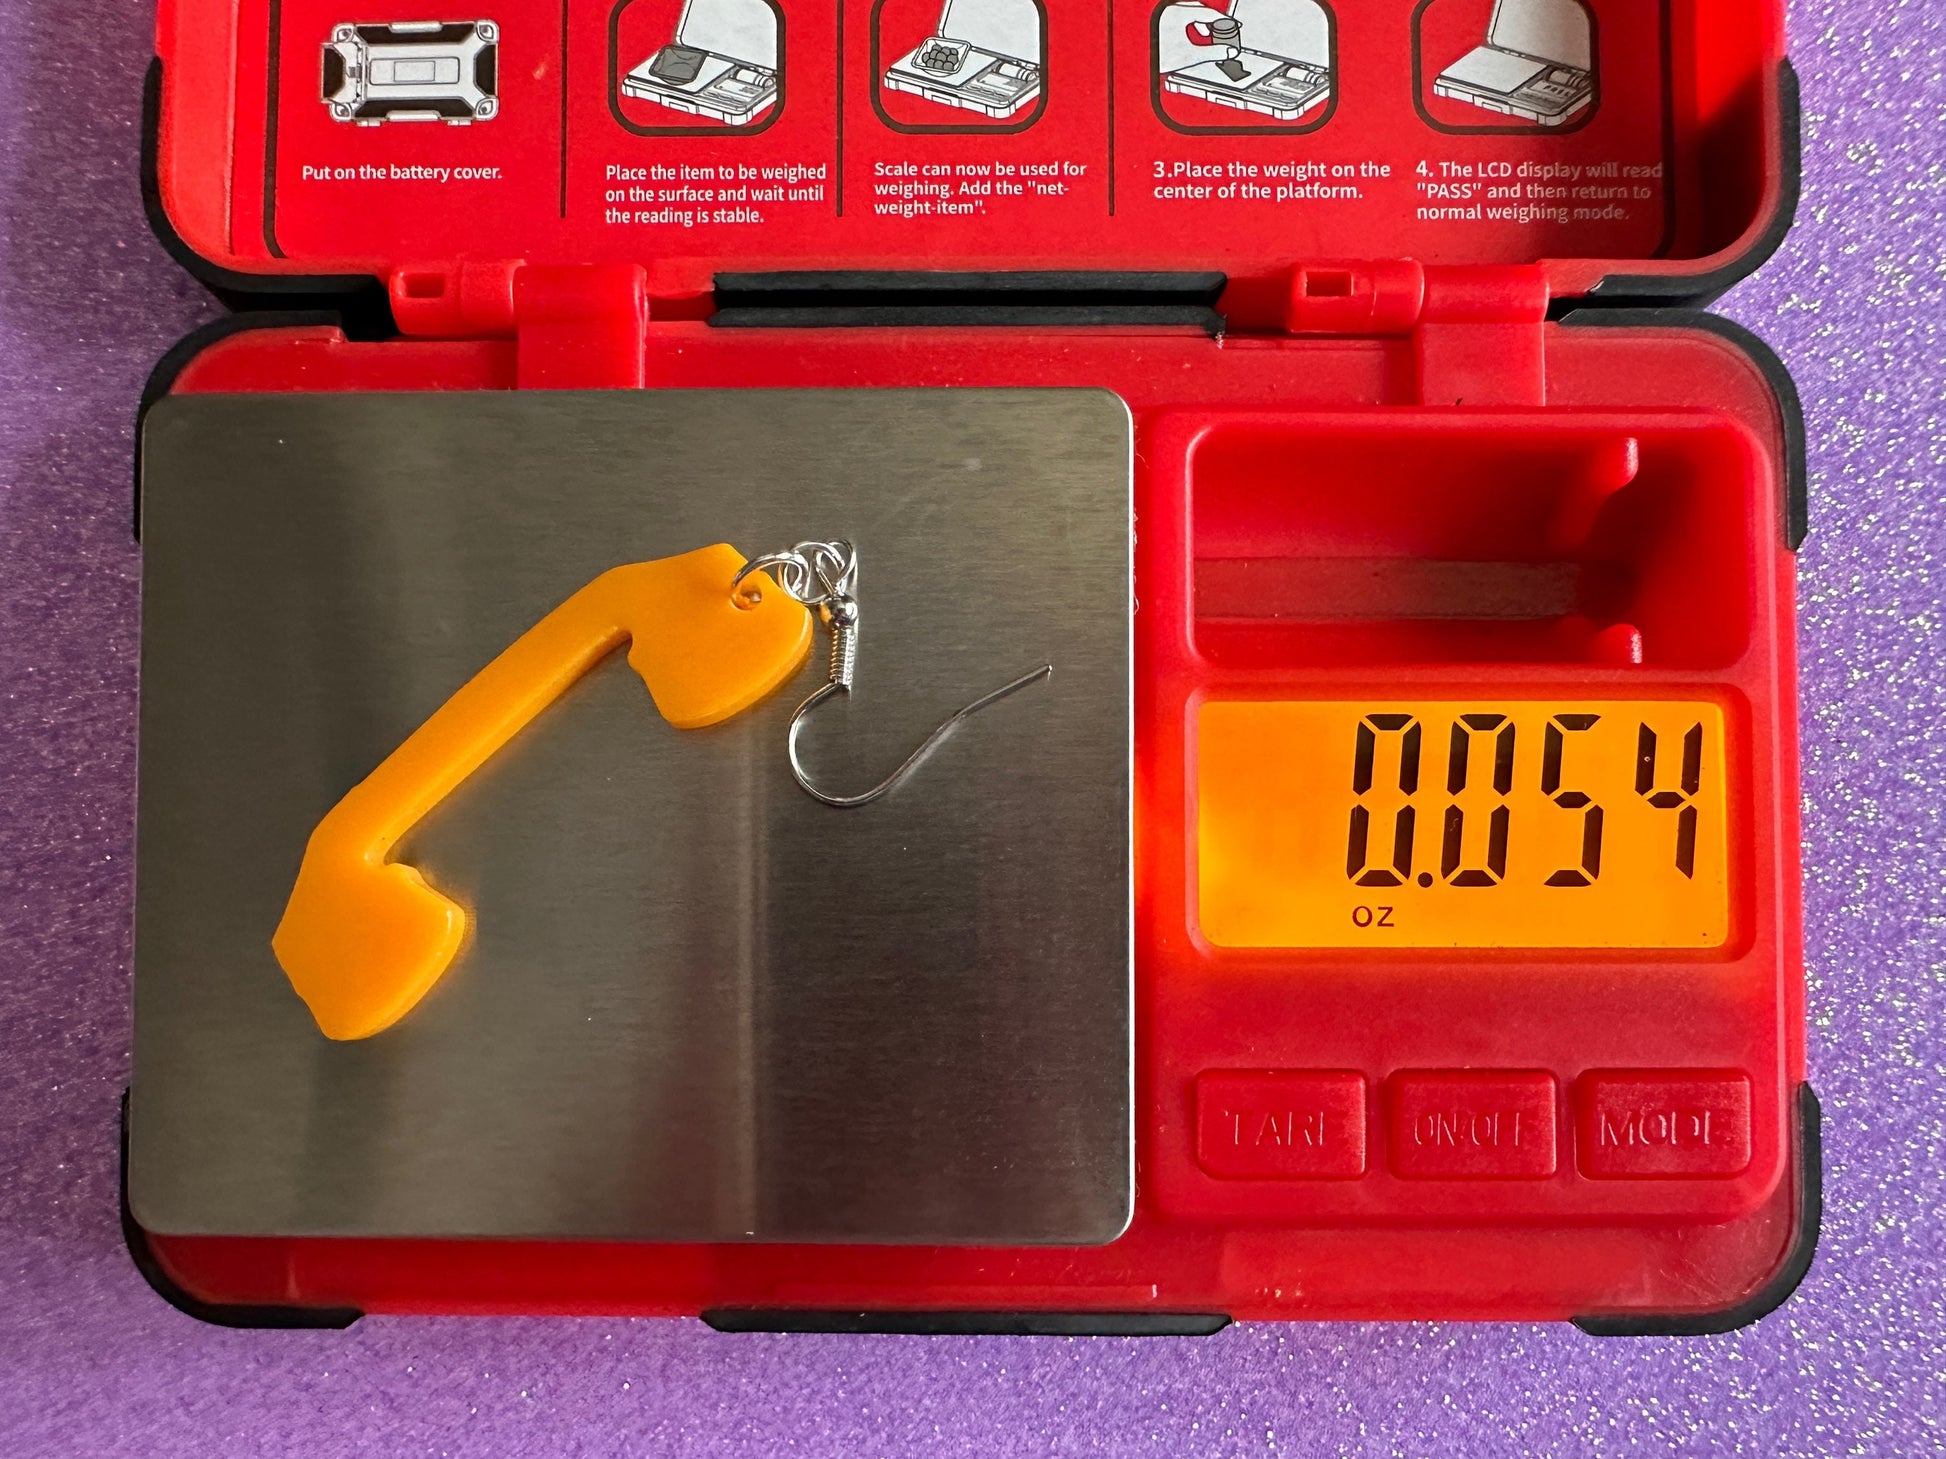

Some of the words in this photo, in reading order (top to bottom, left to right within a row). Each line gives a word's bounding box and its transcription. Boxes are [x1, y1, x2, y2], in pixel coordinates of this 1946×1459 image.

[301, 164, 332, 181] Put
[333, 167, 356, 181] on
[357, 163, 387, 180] the
[389, 163, 451, 184] battery
[453, 166, 503, 180] cover.
[605, 163, 648, 181] Place
[649, 163, 677, 181] the
[679, 163, 715, 181] item
[717, 164, 735, 181] to
[738, 162, 758, 180] be
[760, 162, 827, 184] weighed
[873, 160, 919, 177] Scale
[921, 164, 952, 177] can
[955, 164, 992, 177] now
[995, 160, 1016, 177] be
[1019, 160, 1059, 177] used
[1062, 160, 1088, 177] for
[1226, 160, 1259, 178] the
[1262, 160, 1327, 182] weight
[1330, 164, 1355, 178] on
[1359, 160, 1391, 178] the
[1415, 159, 1435, 178] 4.
[1437, 160, 1473, 178] The
[1477, 161, 1513, 178] LCD
[1516, 160, 1582, 182] display
[604, 189, 626, 203] on
[628, 185, 655, 203] the
[657, 184, 714, 202] surface
[717, 184, 747, 202] and
[750, 184, 785, 202] wait
[788, 184, 824, 202] until
[873, 179, 955, 200] weighing.
[958, 179, 992, 196] Add
[994, 179, 1024, 196] the
[1027, 179, 1070, 196] "net-
[1152, 183, 1214, 199] center
[1217, 181, 1238, 199] of
[1240, 181, 1272, 200] the
[1276, 181, 1364, 203] platform.
[1416, 181, 1482, 200] "PASS"
[1486, 181, 1521, 199] and
[1525, 182, 1568, 199] then
[1571, 185, 1628, 199] return
[1632, 186, 1652, 199] to
[604, 206, 631, 225] the
[634, 206, 694, 228] reading
[696, 206, 710, 224] is
[712, 205, 765, 224] stable.
[873, 199, 987, 219] weight-item".
[1416, 202, 1483, 221] normal
[1485, 202, 1570, 225] weighing
[1345, 712, 1703, 889] 0.054
[1600, 1108, 1727, 1147] MODE
